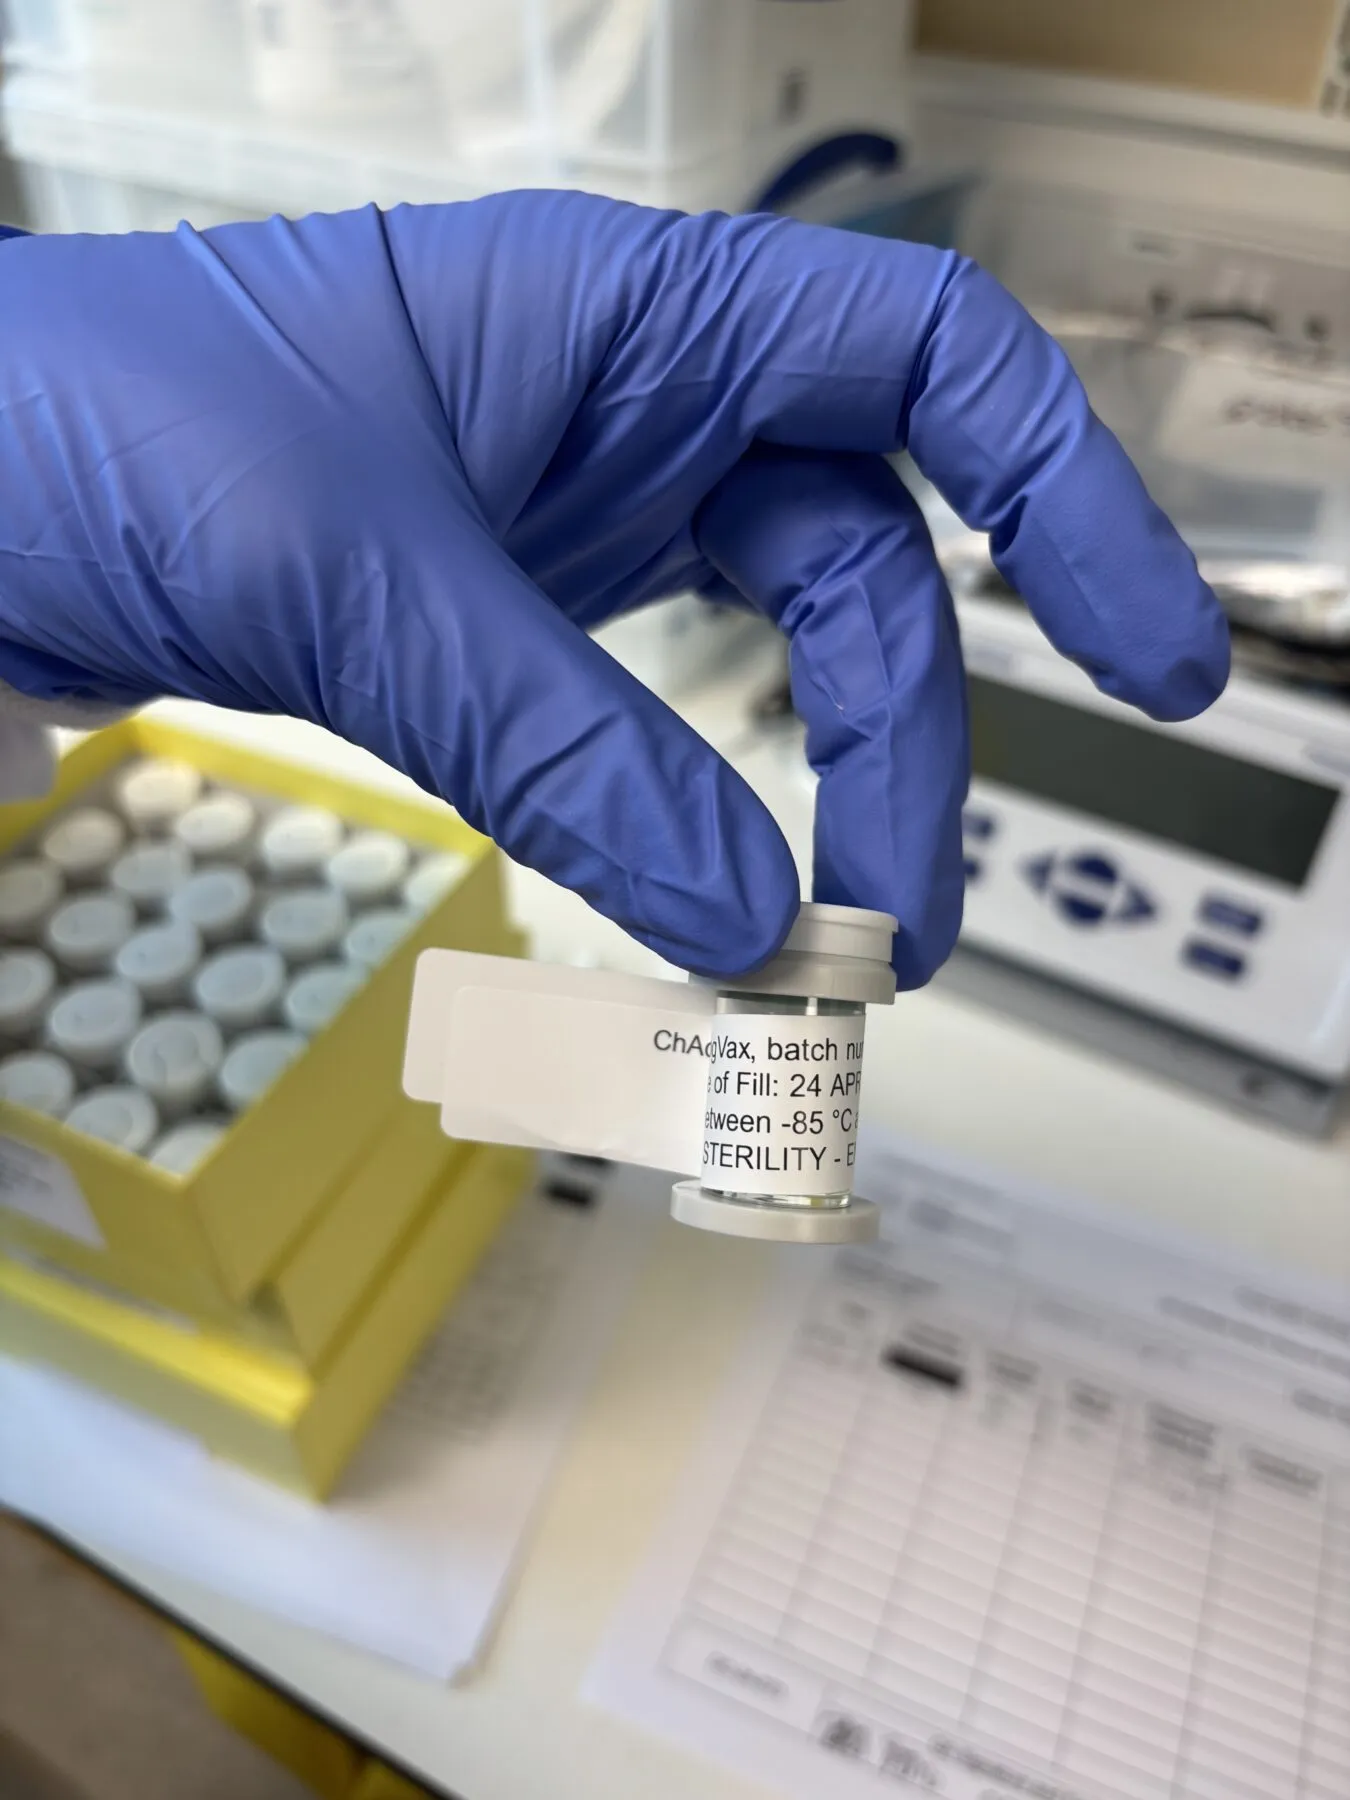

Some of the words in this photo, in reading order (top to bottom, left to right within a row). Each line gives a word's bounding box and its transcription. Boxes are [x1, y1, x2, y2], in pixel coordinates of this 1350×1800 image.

[767, 1036, 838, 1061] batch
[714, 1070, 730, 1094] of
[736, 1071, 778, 1097] Fill:
[789, 1073, 822, 1098] 24
[781, 1110, 824, 1135] -85
[832, 1108, 852, 1132] °C
[703, 1140, 827, 1171] STERILITY
